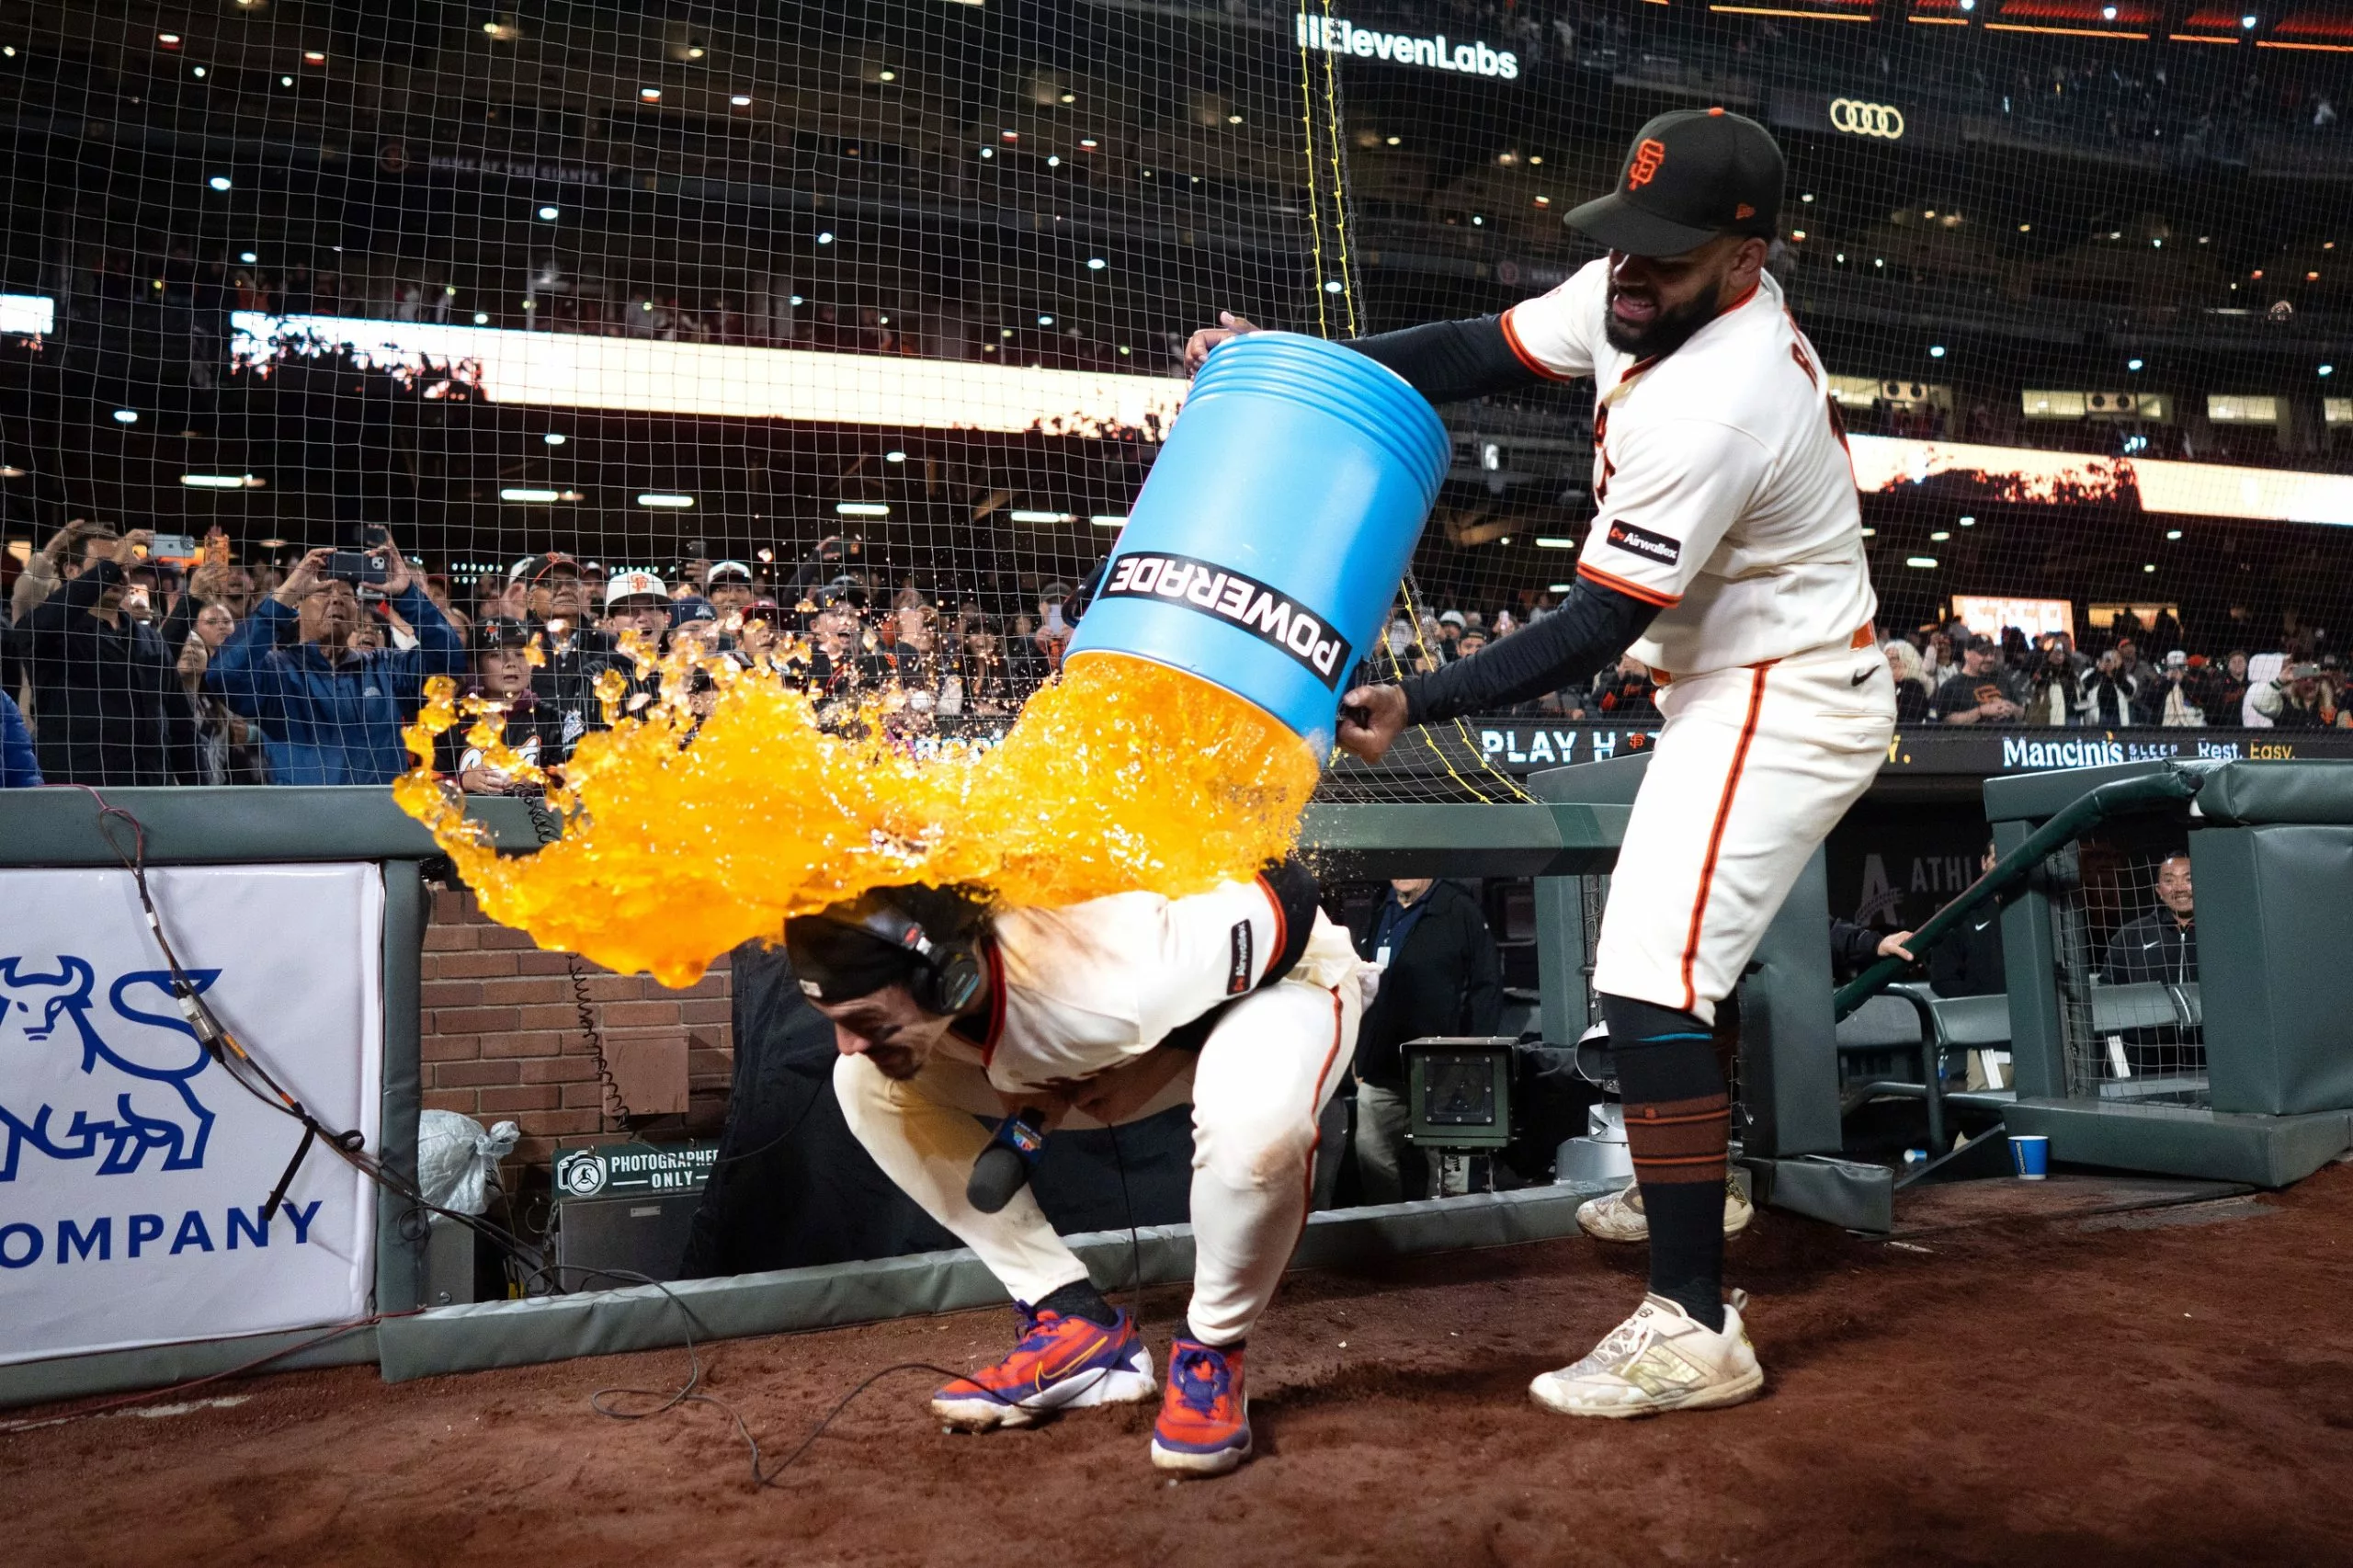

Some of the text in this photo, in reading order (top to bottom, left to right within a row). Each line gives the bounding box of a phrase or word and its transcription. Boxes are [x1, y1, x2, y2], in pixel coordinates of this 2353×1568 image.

[1623, 532, 1677, 559] Airwallex
[1108, 557, 1342, 676] POWERADE
[1481, 731, 1576, 763] PLAY
[2129, 743, 2177, 756] SLEEP
[652, 1170, 693, 1188] ONLY
[0, 1200, 323, 1269] OMPANY
